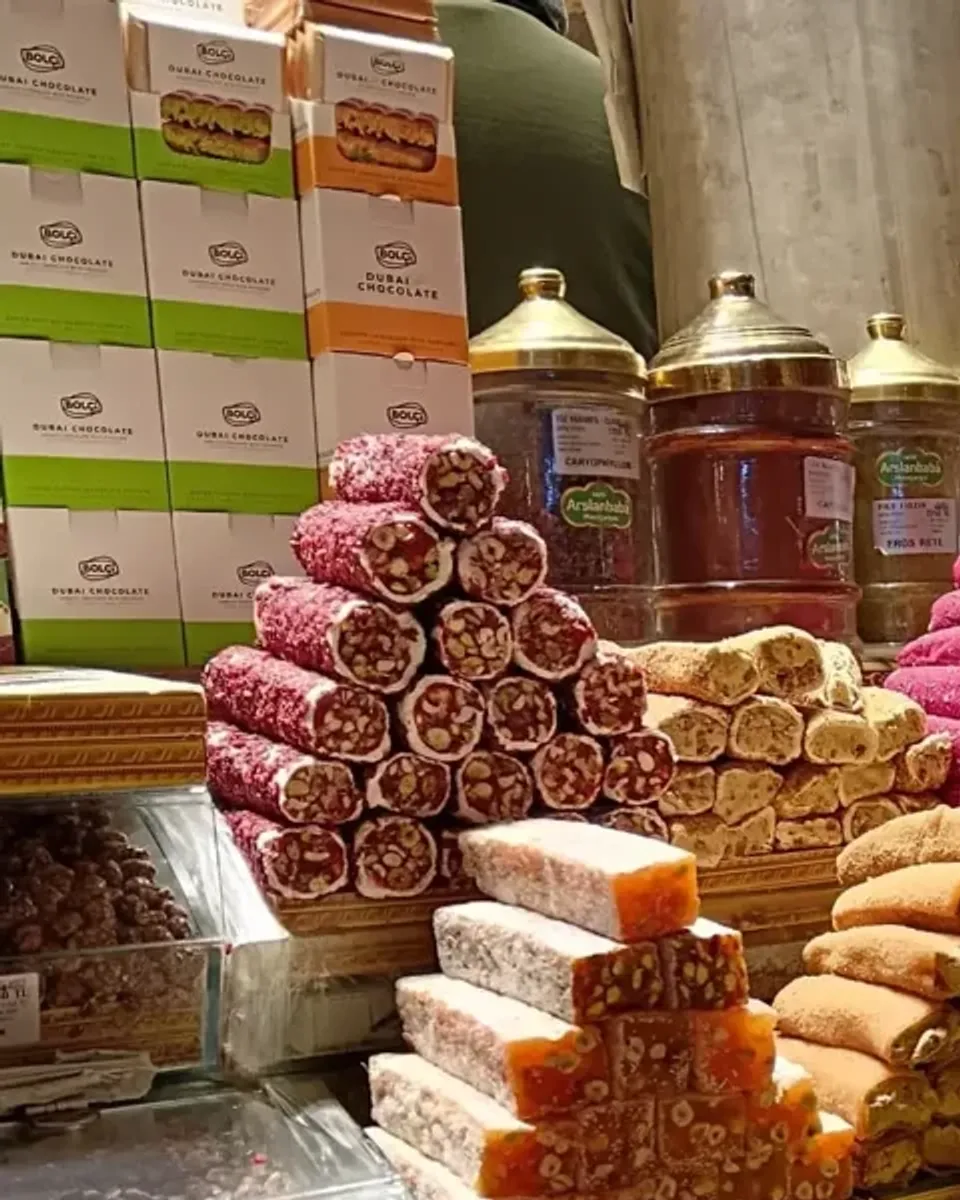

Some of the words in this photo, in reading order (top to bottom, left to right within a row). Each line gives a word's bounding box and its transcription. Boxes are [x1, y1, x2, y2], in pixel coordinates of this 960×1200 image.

[168, 64, 202, 77] DUBAI
[205, 70, 266, 85] CHOCOLATE
[0, 74, 27, 85] UBAI
[32, 79, 97, 96] CHOCOLATE
[11, 250, 47, 261] DUBAI
[50, 254, 113, 268] CHOCOLATE
[182, 269, 215, 279] DUBAI
[218, 273, 276, 286] CHOCOLATE
[365, 271, 410, 285] DUBAI
[357, 281, 439, 299] CHOCOLATE
[32, 422, 68, 432] DUBAI
[71, 424, 133, 435] CHOCOLATE
[196, 430, 229, 440] DUBAI
[231, 432, 288, 443] CHOCOLATE
[51, 587, 85, 596] DUBAI
[88, 587, 150, 596] CHOCOLATE
[211, 591, 244, 600] DUBAI
